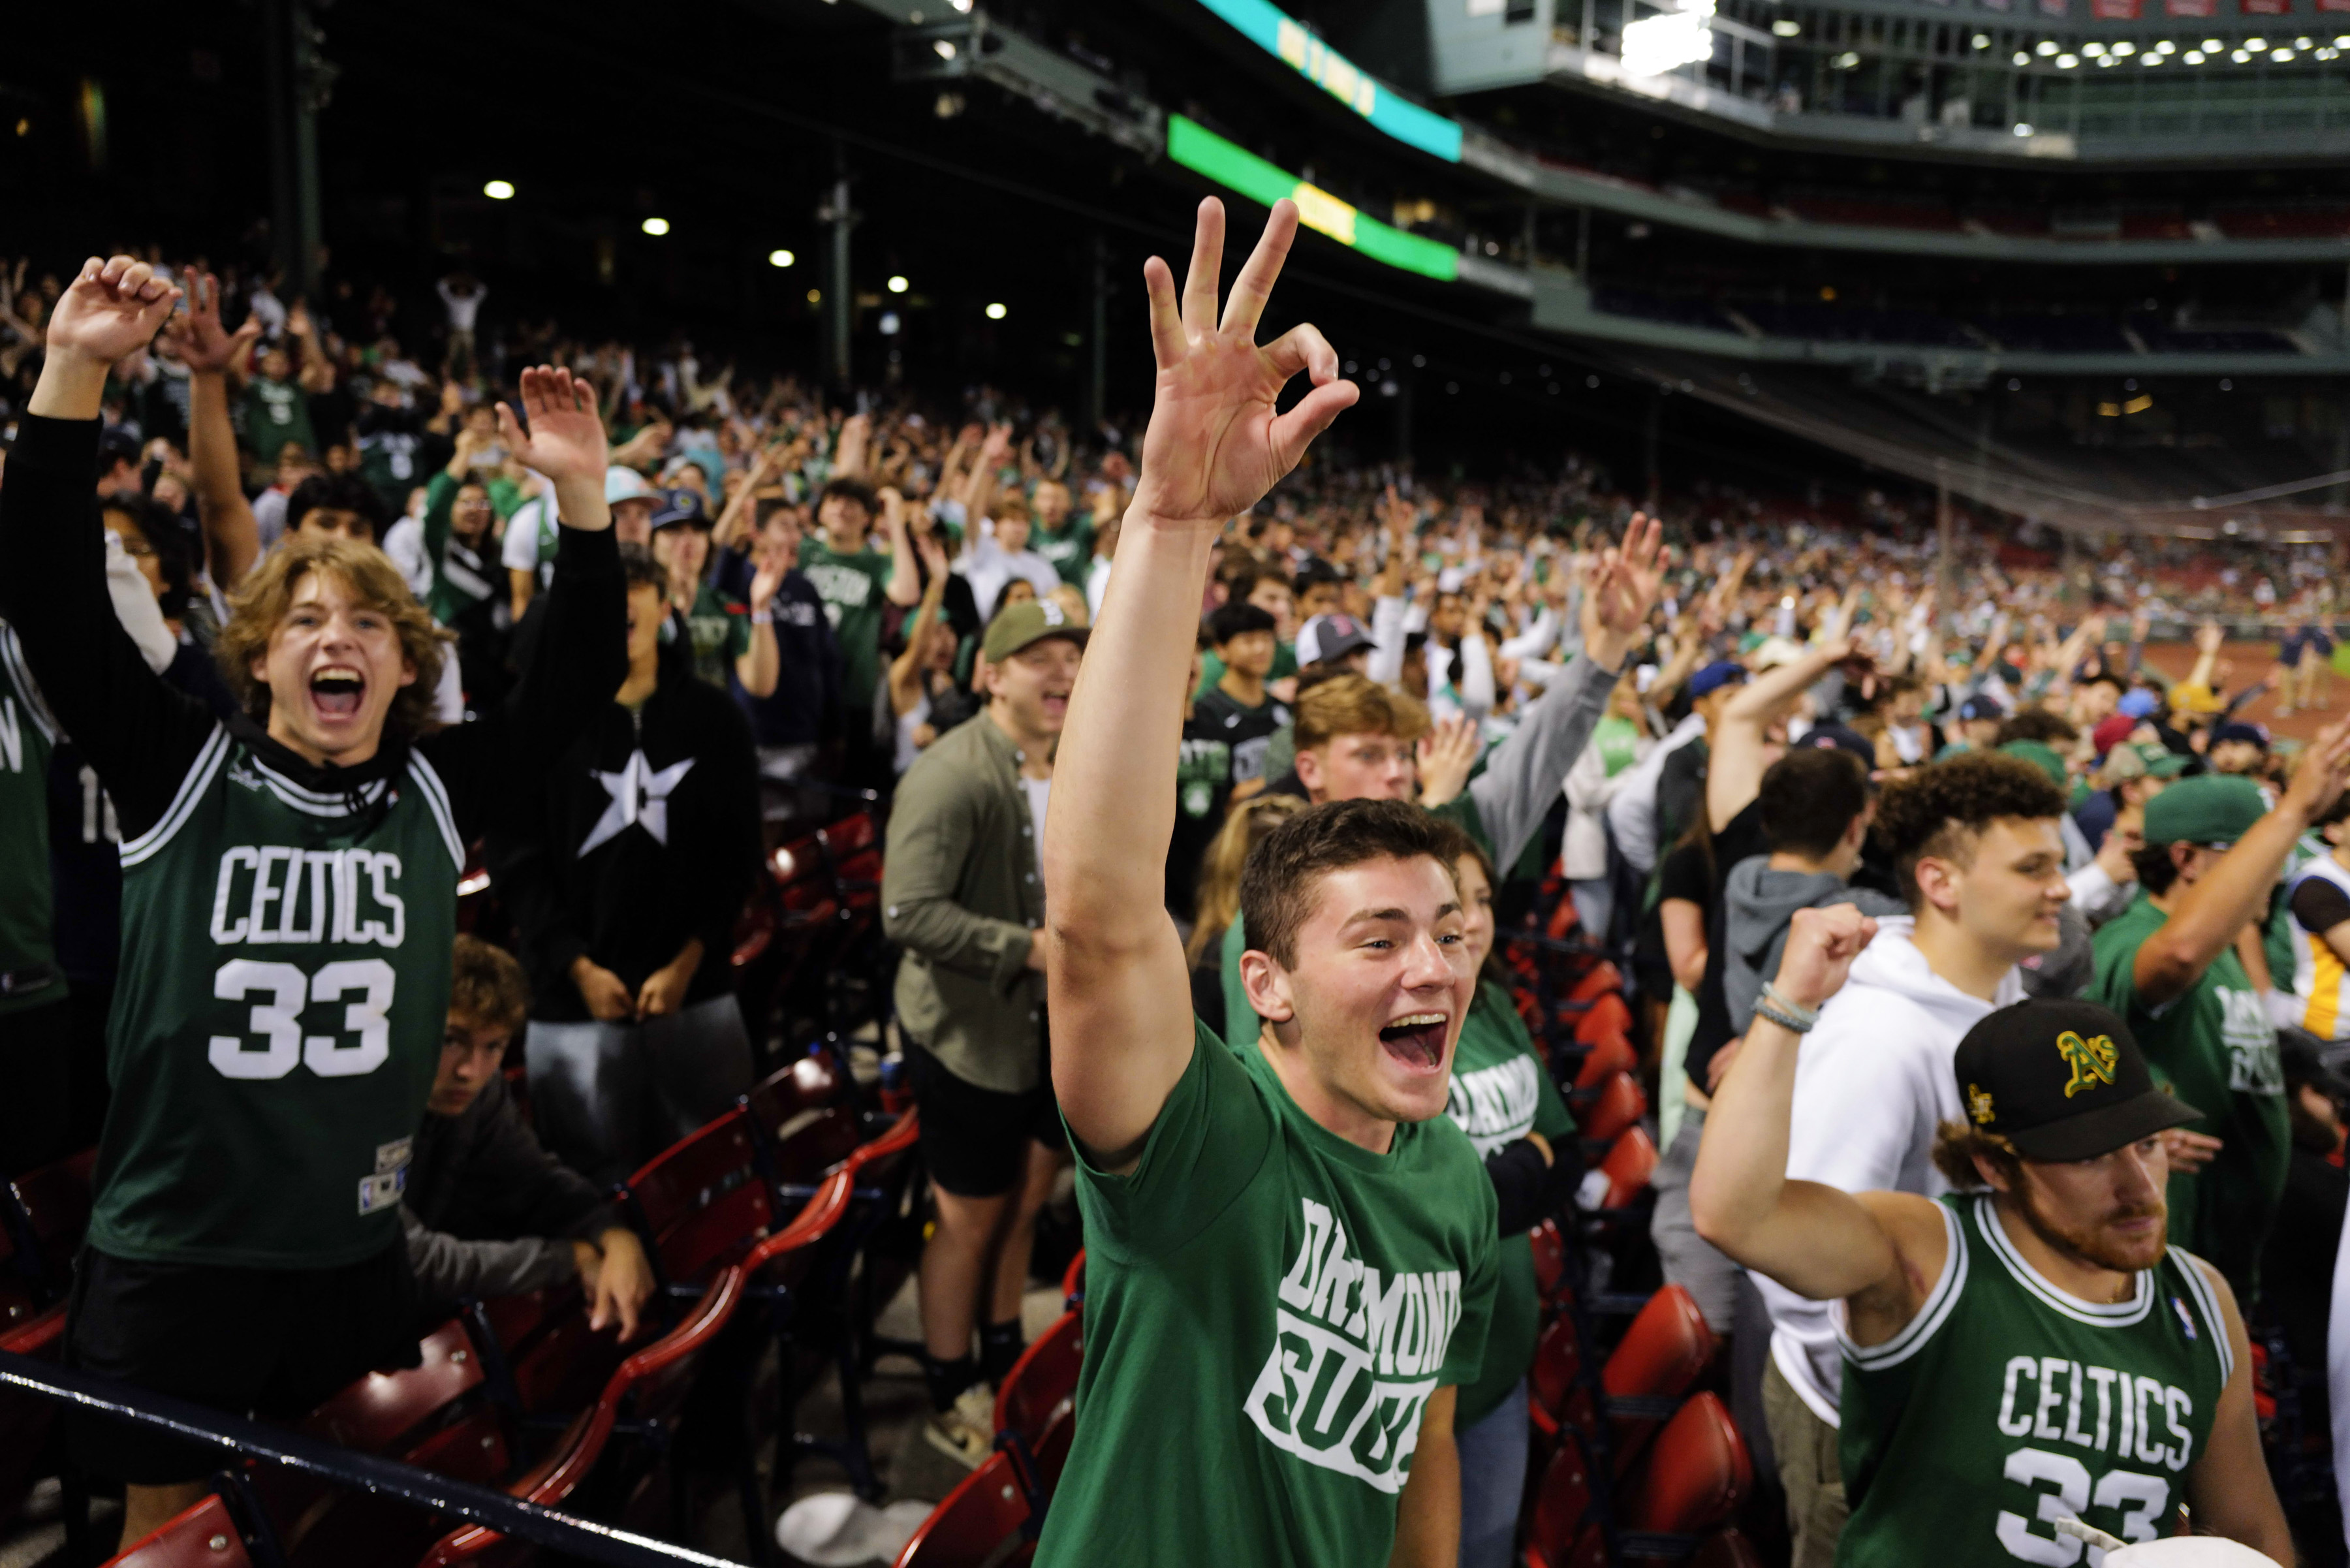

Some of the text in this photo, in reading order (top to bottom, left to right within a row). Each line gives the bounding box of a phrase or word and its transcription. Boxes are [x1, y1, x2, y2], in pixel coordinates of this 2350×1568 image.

[210, 845, 405, 949] CELTICS
[208, 958, 396, 1080] 33
[1998, 1355, 2193, 1472] CELTICS
[1996, 1447, 2170, 1568] 33
